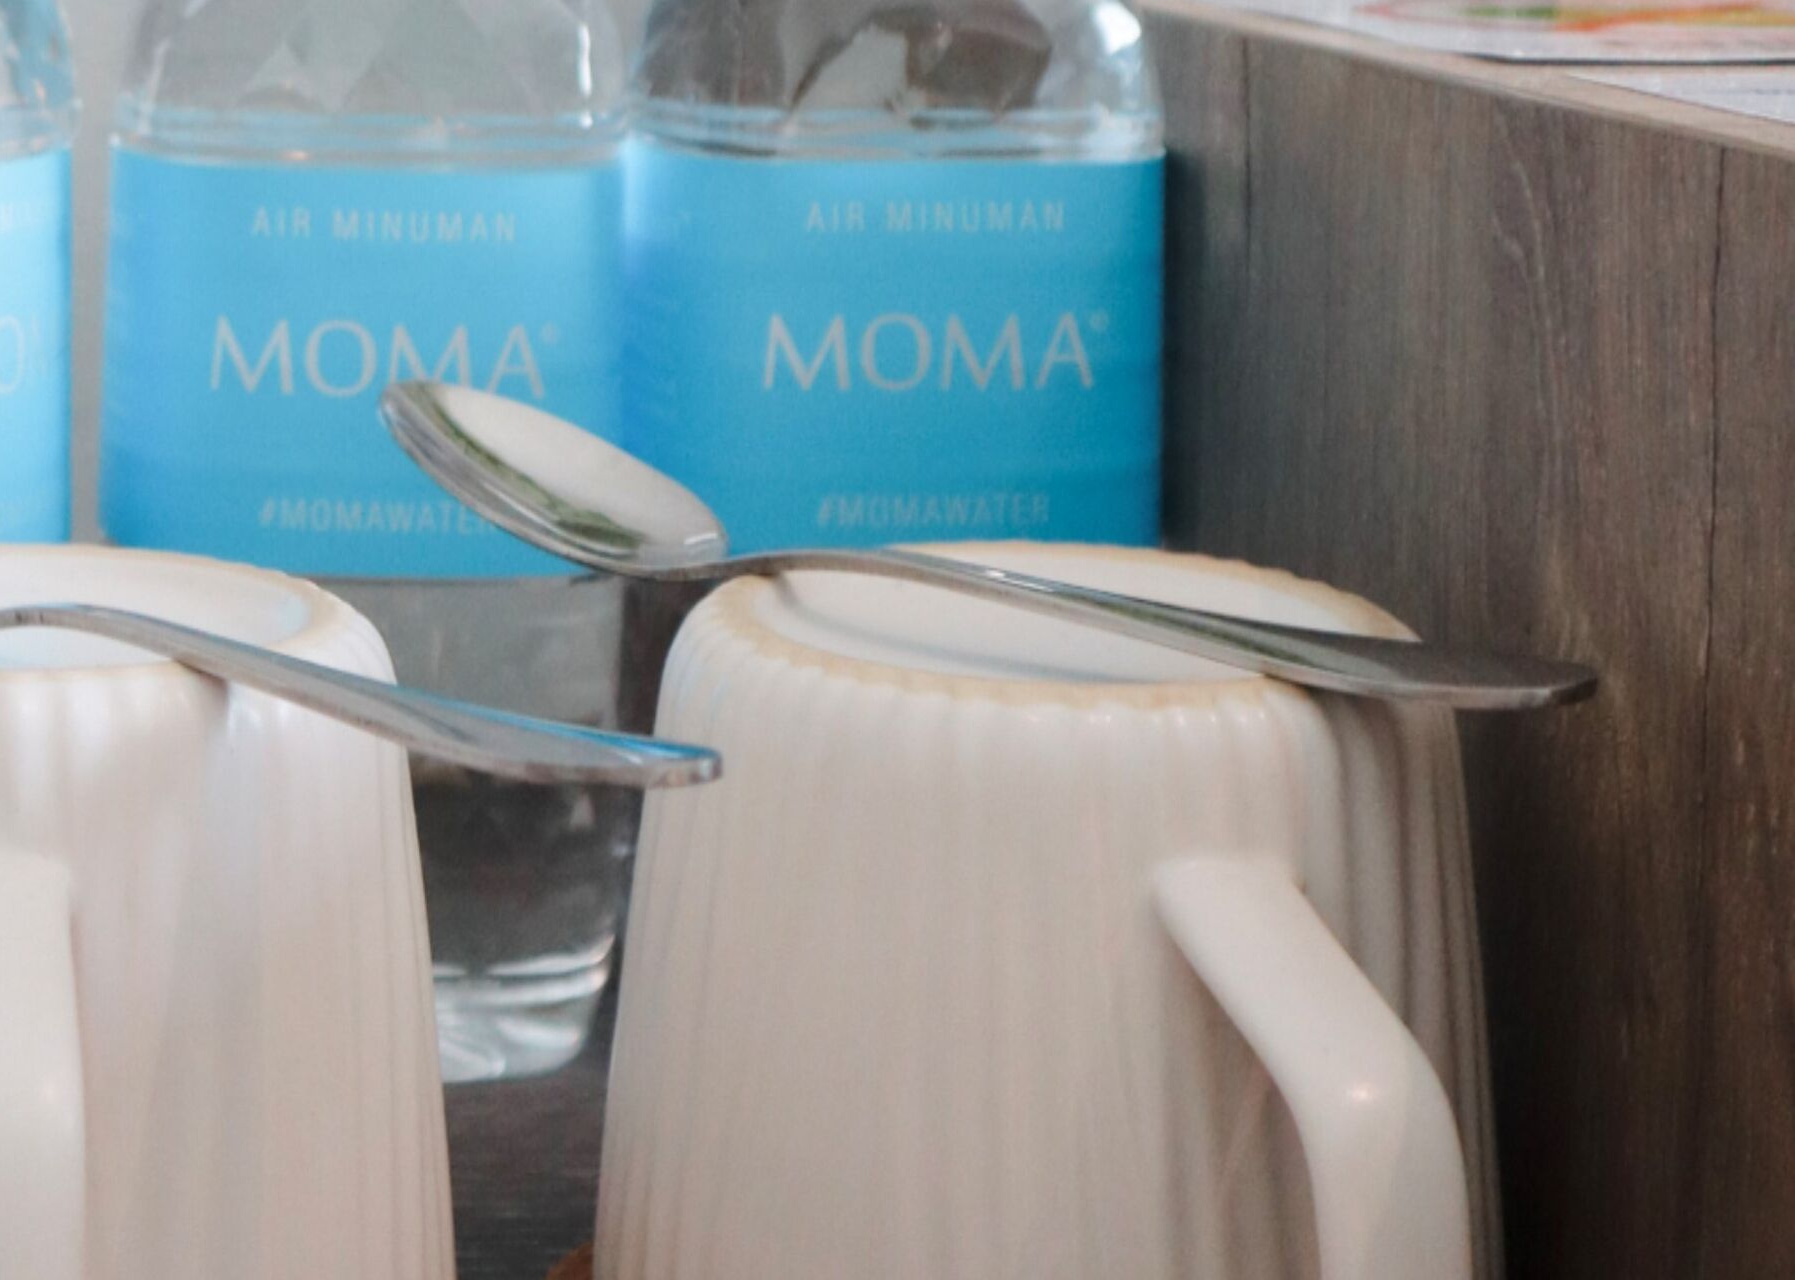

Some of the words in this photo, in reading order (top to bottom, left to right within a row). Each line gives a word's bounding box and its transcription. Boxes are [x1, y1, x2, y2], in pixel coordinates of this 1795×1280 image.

[251, 206, 312, 238] AIR
[333, 209, 516, 243] MINUMAN
[808, 201, 866, 232] AIR
[887, 201, 1066, 233] MINUMAN
[763, 311, 1095, 392] MOMA
[817, 492, 1050, 528] #MOMAWATER
